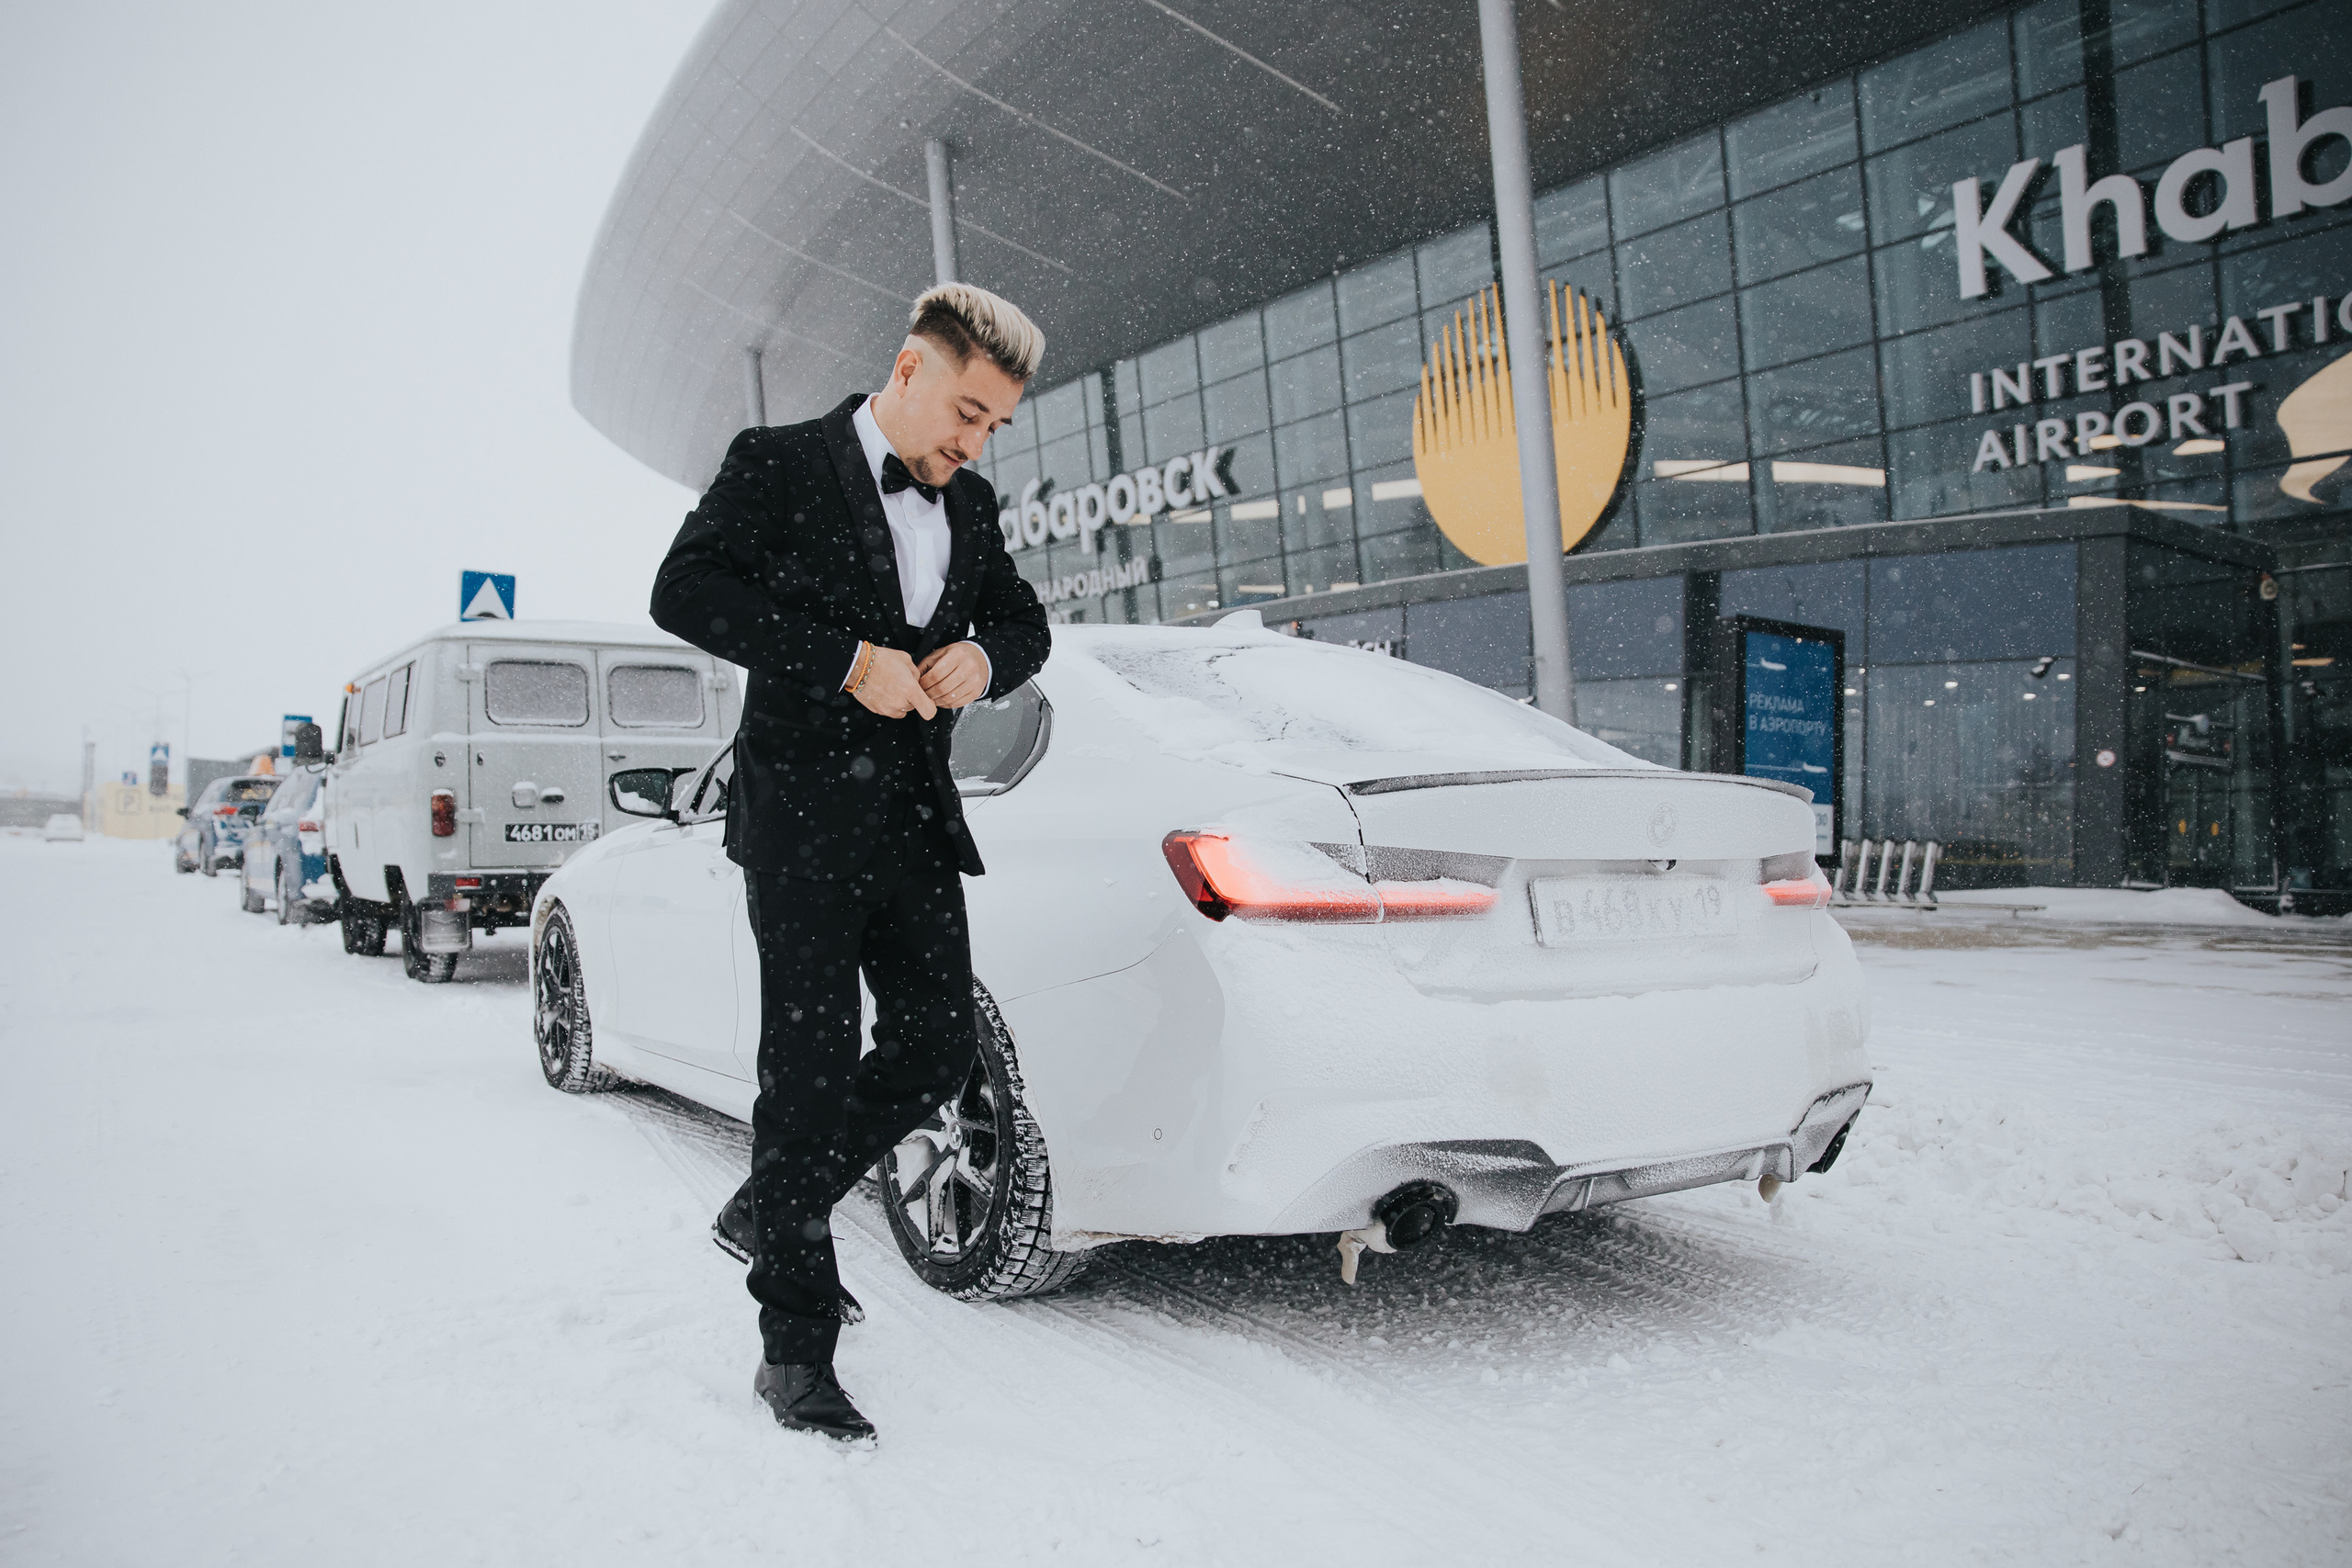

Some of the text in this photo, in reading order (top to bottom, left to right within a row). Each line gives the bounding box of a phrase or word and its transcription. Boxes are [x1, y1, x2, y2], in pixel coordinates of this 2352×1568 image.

[1952, 74, 2352, 300] Khab
[1973, 381, 2253, 472] AIRPORT
[1034, 555, 1148, 604] НАРОДНЫЙ
[1748, 693, 1805, 714] РЕКЛАМА
[1748, 715, 1827, 737] В АЭРОПОРТУ
